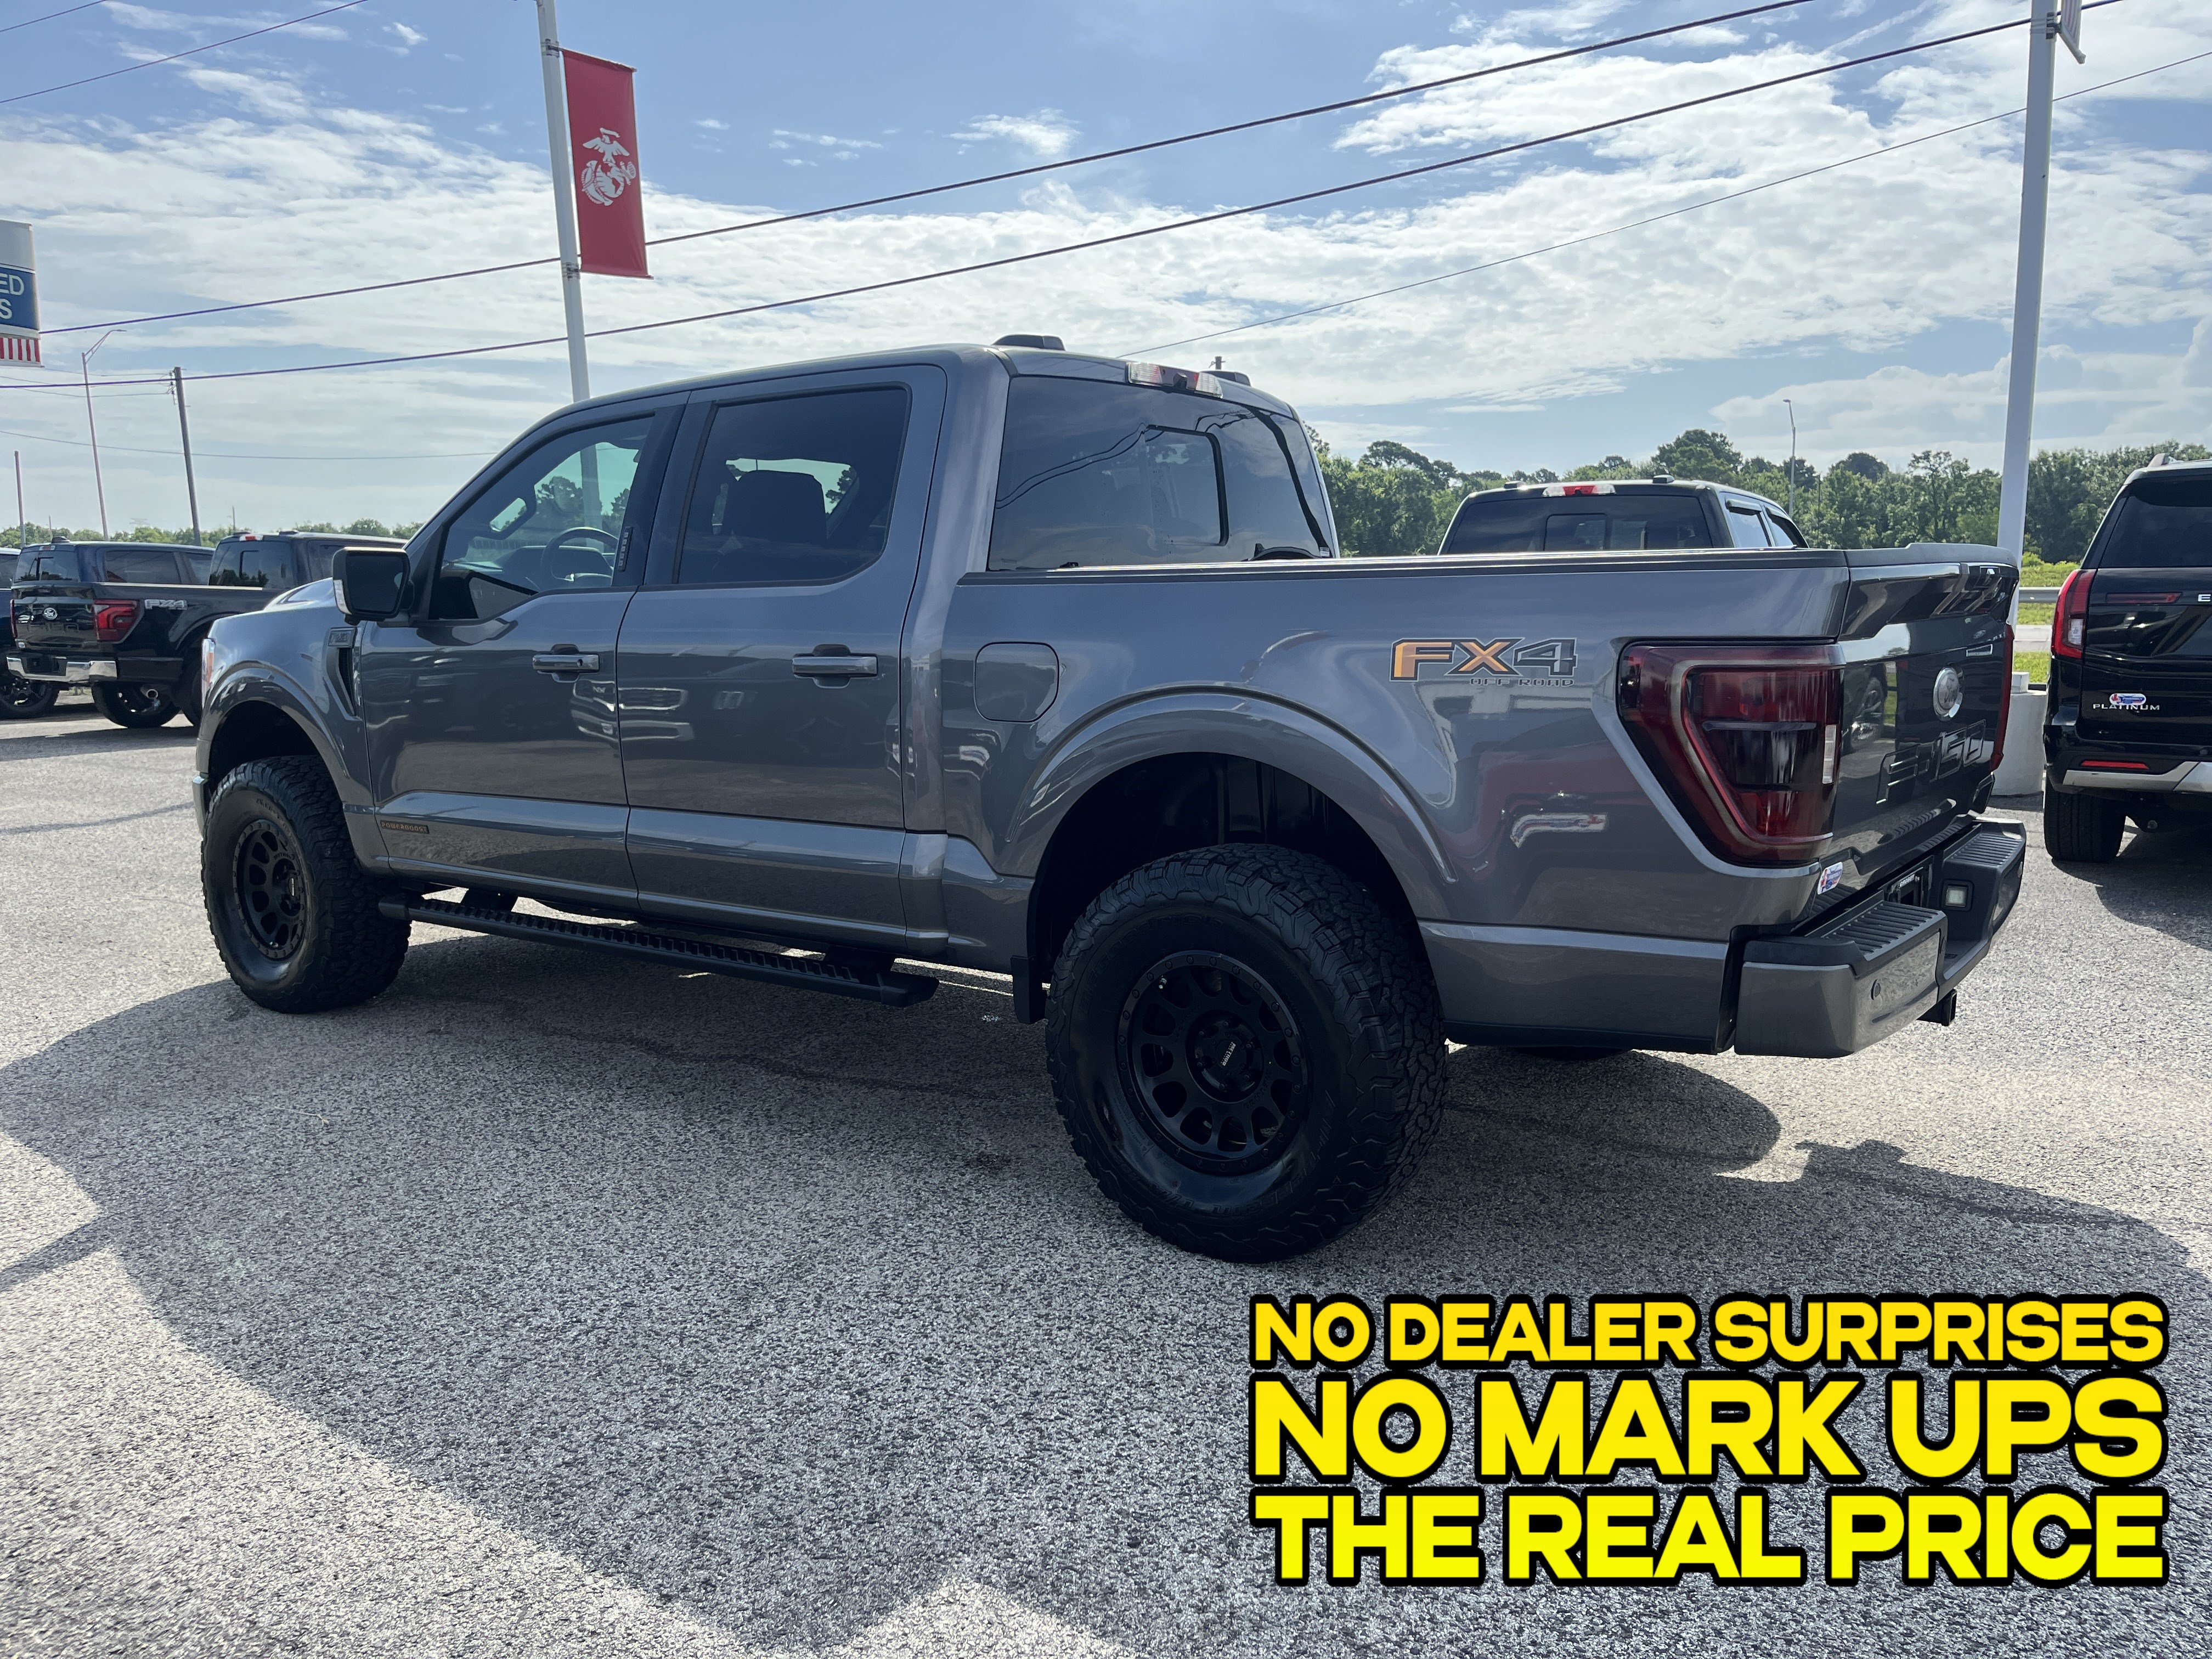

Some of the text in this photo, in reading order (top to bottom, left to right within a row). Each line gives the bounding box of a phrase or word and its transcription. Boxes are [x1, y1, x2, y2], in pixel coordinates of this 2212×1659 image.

[1389, 637, 1578, 682] FX4
[1469, 678, 1576, 687] OFF ROAD
[381, 821, 428, 833] POWERBOOST
